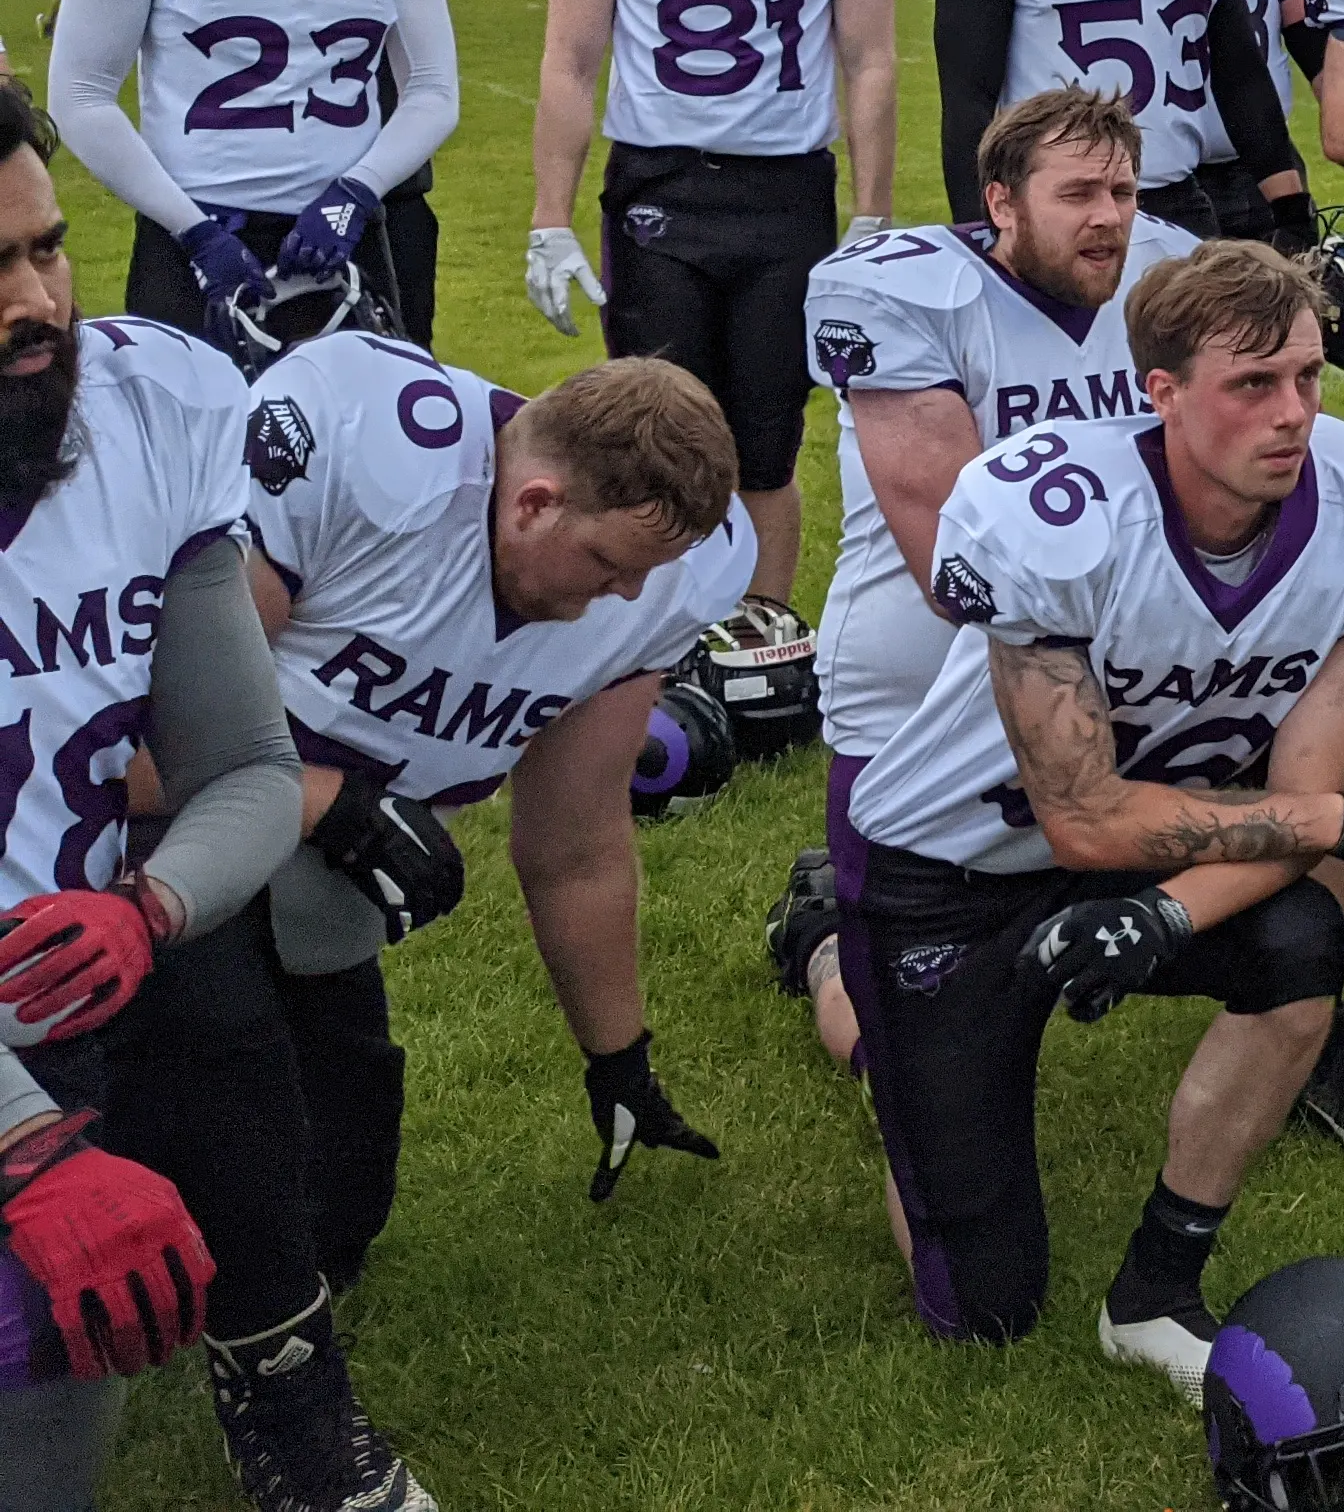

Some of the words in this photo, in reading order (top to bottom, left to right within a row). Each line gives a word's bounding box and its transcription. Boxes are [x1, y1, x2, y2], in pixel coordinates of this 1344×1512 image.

[183, 16, 388, 135] 23
[998, 369, 1153, 438] RAM
[982, 432, 1107, 528] 36
[311, 634, 573, 749] RAMS
[752, 640, 812, 665] Riddell
